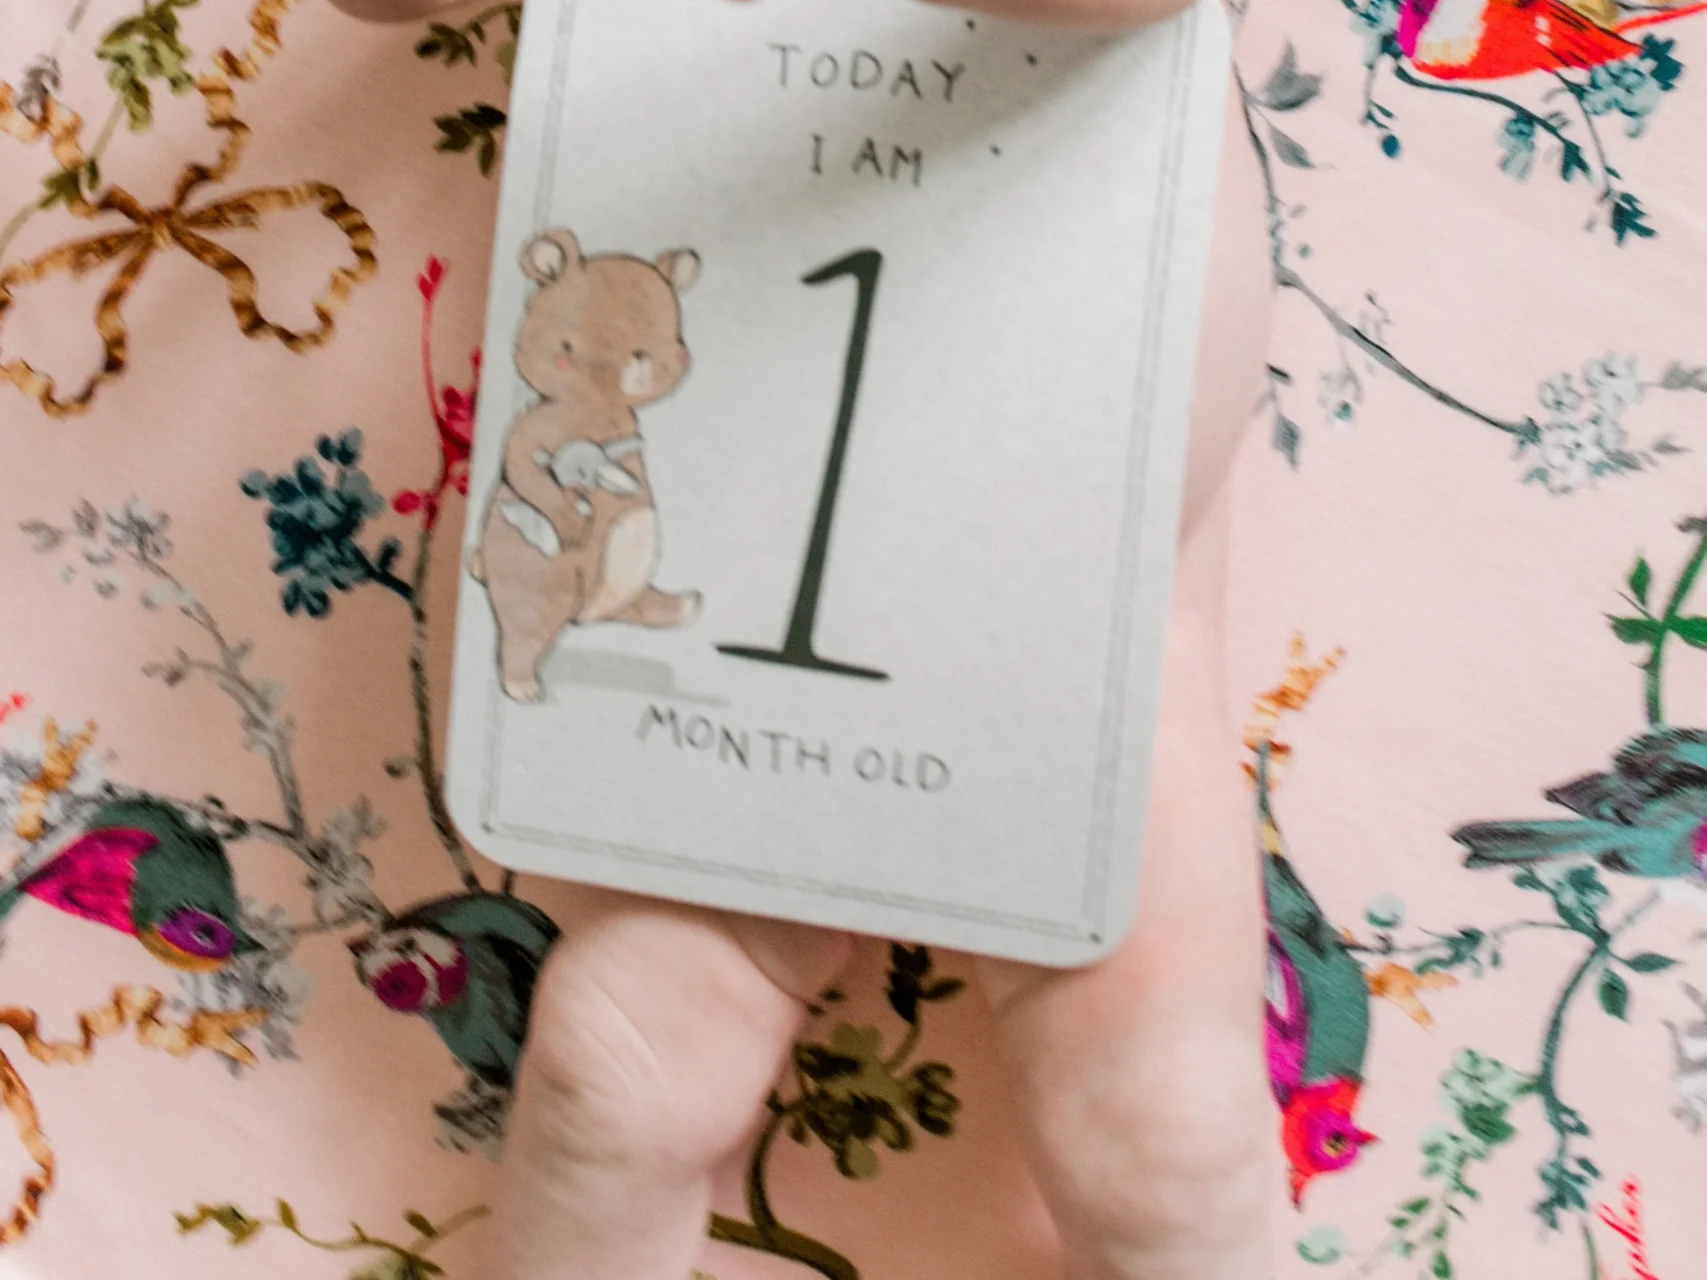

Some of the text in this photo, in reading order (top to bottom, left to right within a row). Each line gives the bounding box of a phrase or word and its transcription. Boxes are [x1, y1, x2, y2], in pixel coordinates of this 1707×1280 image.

[766, 41, 966, 103] TODAY
[811, 132, 924, 188] I AM
[713, 247, 893, 682] 1
[634, 703, 952, 793] MONTH OLD
